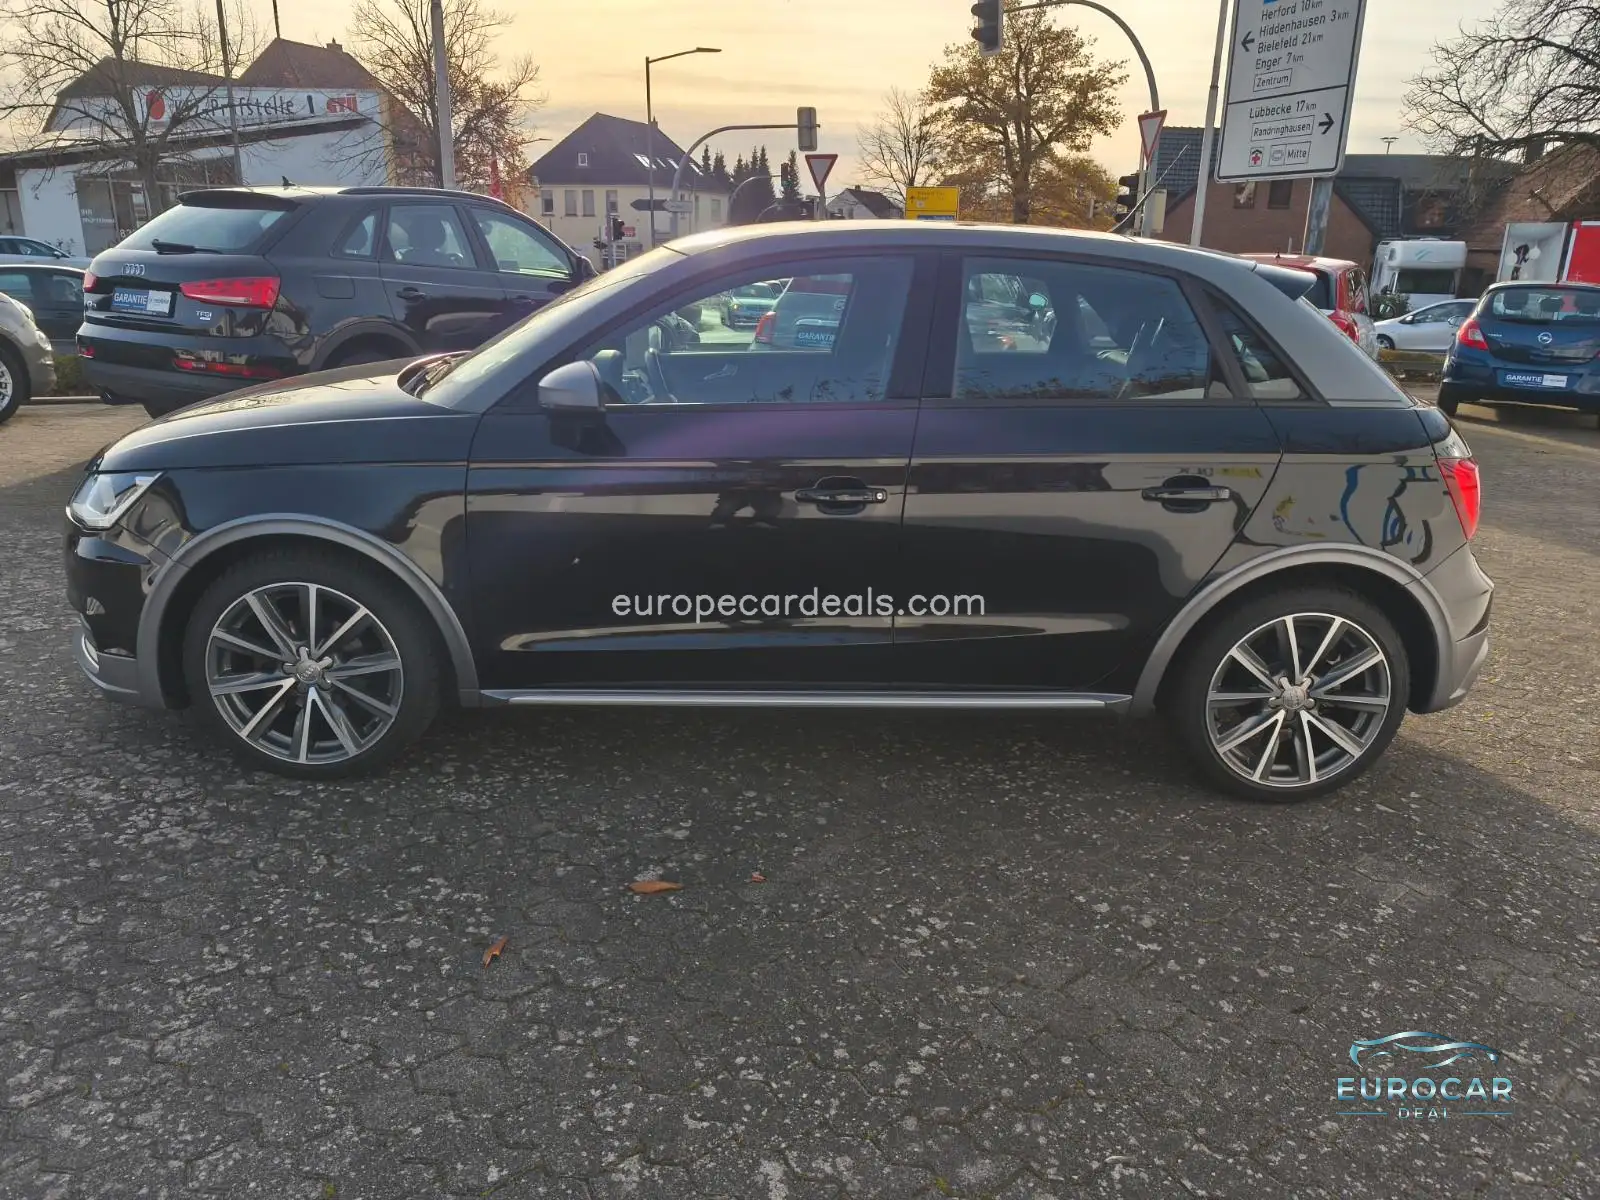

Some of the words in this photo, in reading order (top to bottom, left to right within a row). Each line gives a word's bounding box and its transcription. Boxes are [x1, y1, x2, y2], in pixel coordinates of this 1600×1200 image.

[1261, 3, 1297, 20] Herford
[1259, 15, 1326, 38] Hiddenhausen
[1257, 35, 1298, 54] Bielefeld
[1255, 56, 1282, 71] Enger
[1256, 75, 1289, 88] Zentrum
[1249, 103, 1292, 119] Lübbecke
[1253, 123, 1311, 136] Randringhausen
[1287, 149, 1307, 159] Mitte
[114, 292, 147, 305] GARANTIE
[1506, 374, 1542, 383] GARANTIE
